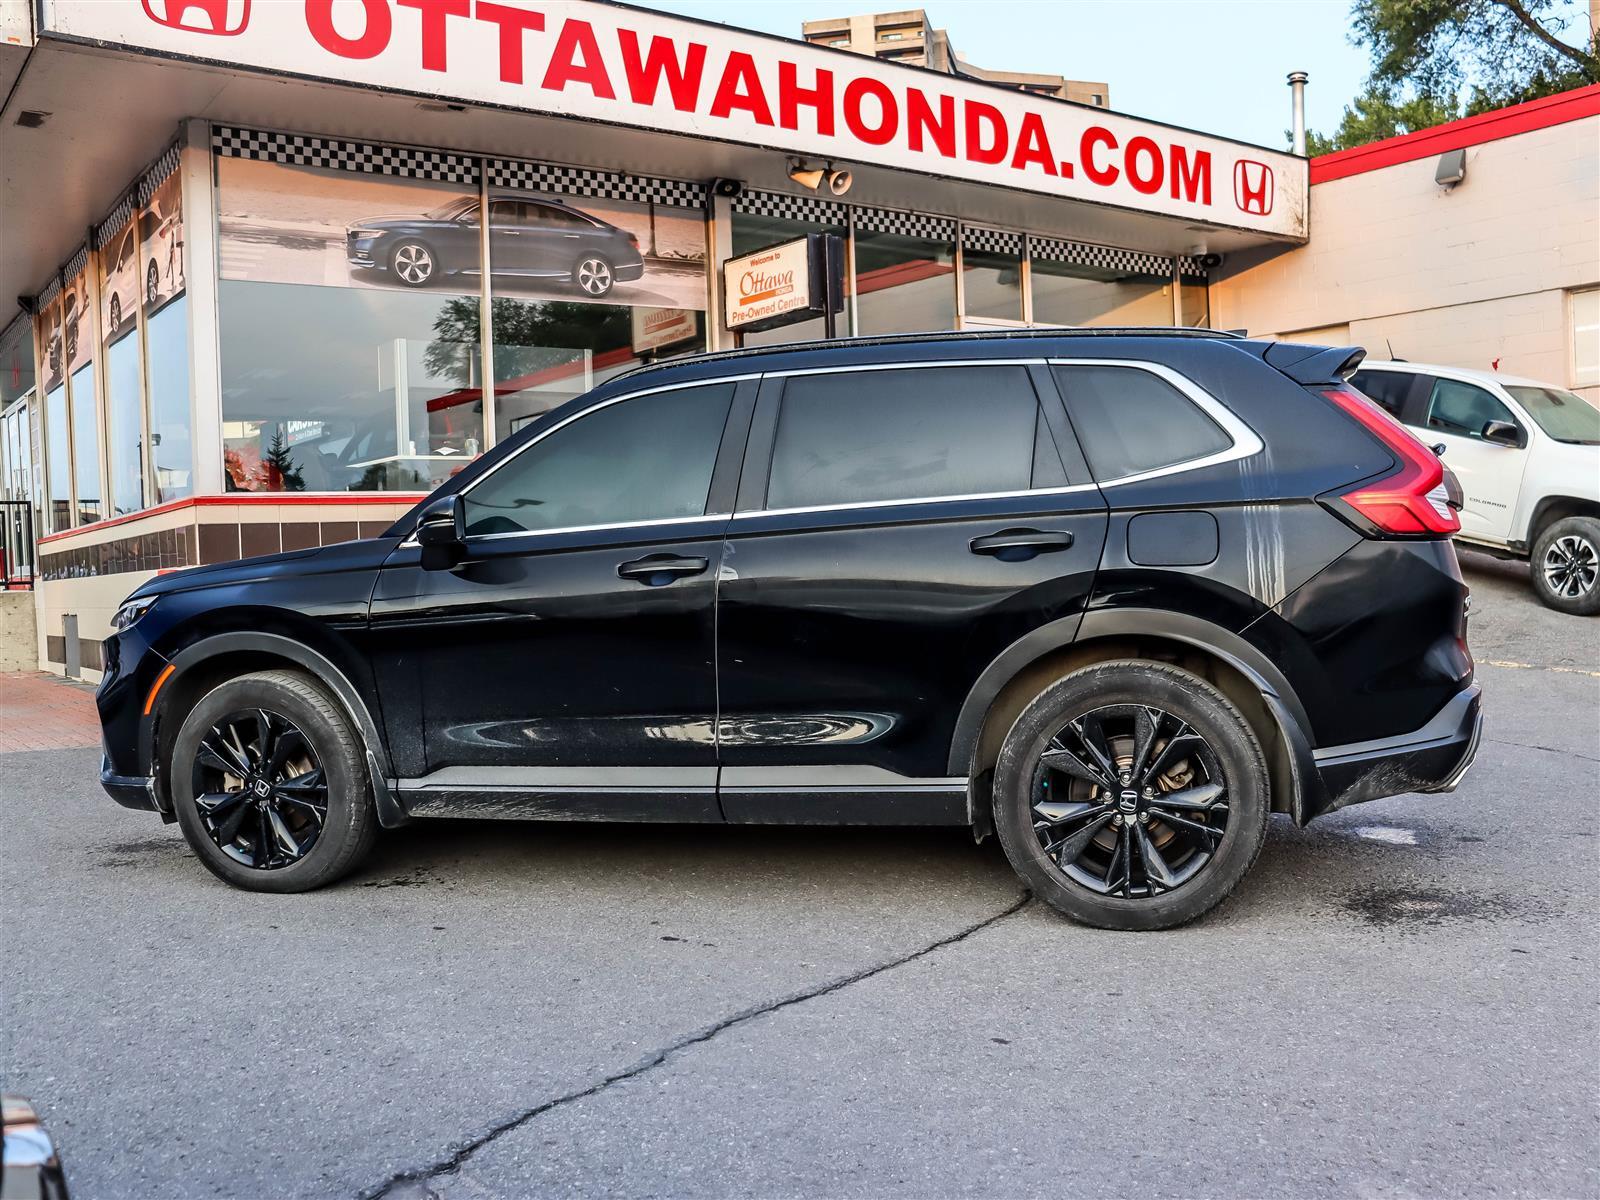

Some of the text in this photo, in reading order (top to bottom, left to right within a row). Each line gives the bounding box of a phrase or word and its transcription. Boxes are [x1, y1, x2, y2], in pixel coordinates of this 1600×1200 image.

[305, 0, 1212, 206] OTTAWAHONDA.COM
[750, 256, 774, 266] Welcome
[740, 270, 793, 296] Ottawa
[732, 296, 805, 322] Pre-Owned Centre
[1469, 497, 1506, 508] COLORADO
